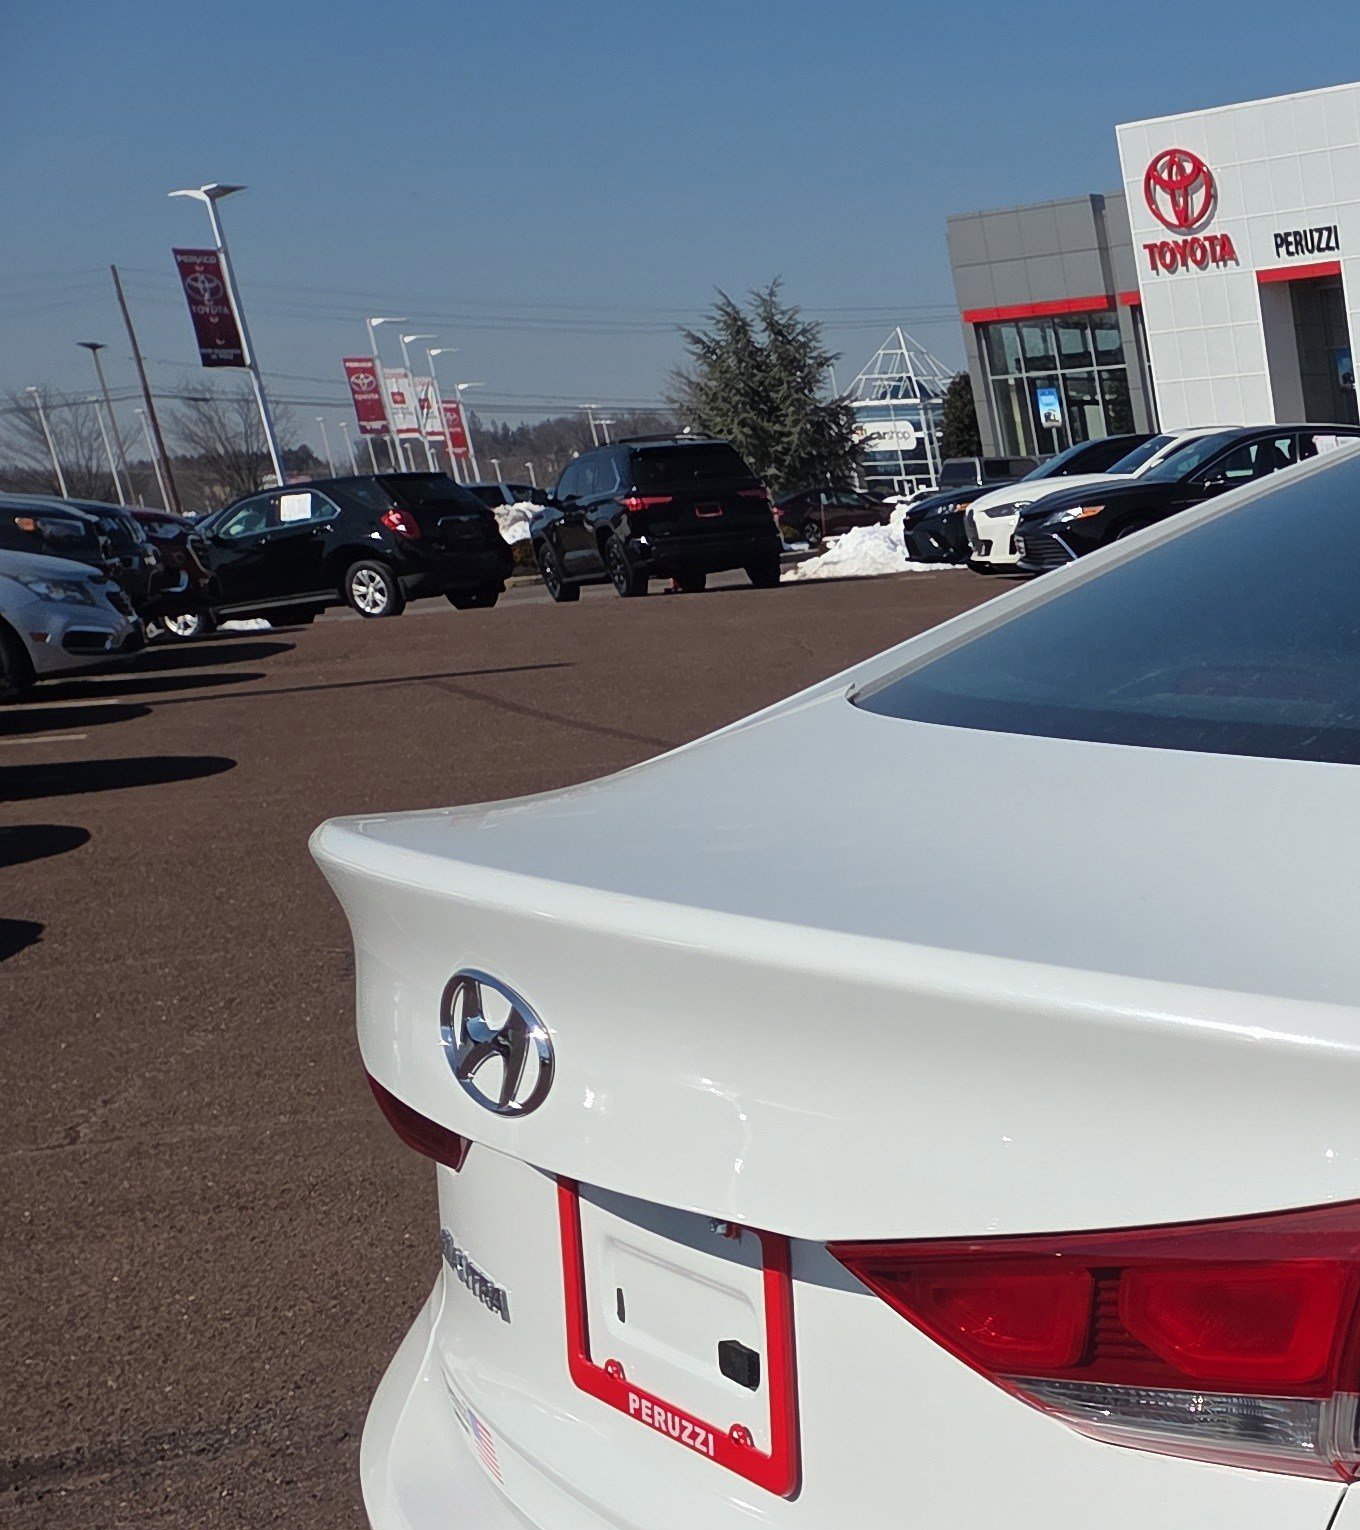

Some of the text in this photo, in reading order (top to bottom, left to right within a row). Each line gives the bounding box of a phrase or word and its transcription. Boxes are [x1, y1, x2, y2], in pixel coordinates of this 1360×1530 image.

[1143, 225, 1341, 273] TOYOTA PERUZZI
[628, 1391, 715, 1457] PERUZZI
